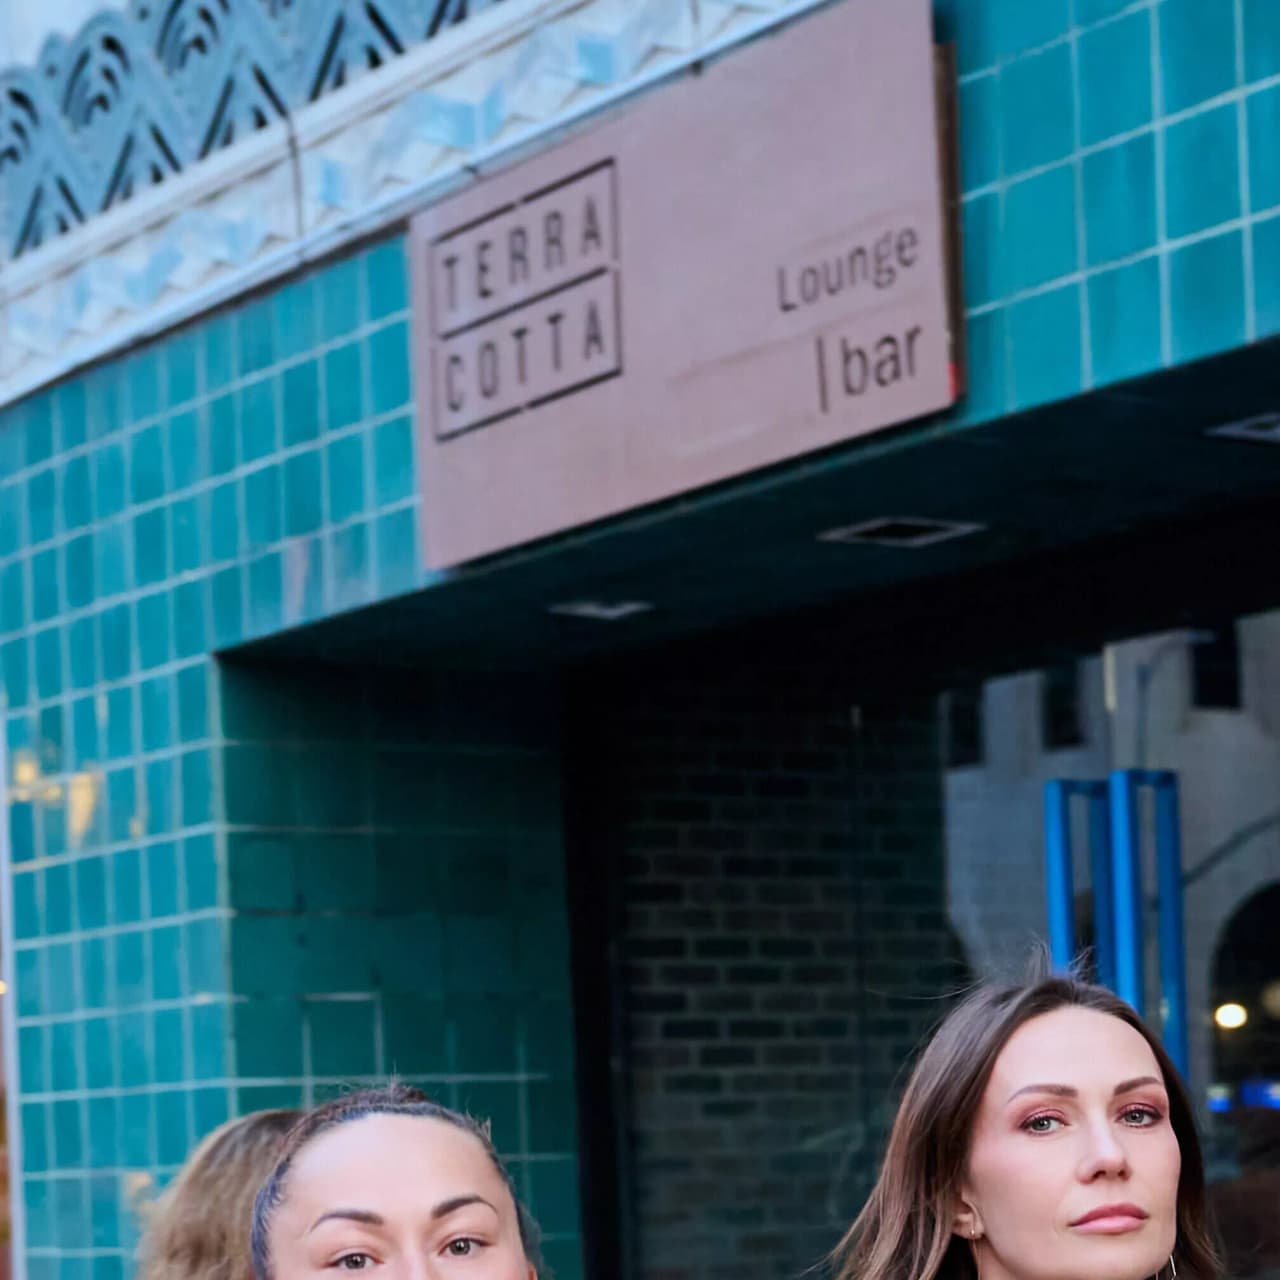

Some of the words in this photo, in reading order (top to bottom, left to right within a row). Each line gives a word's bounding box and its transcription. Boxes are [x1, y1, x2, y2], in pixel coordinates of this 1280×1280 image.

[443, 197, 602, 310] TERRA
[777, 228, 919, 312] Lounge
[445, 304, 604, 412] COTTA
